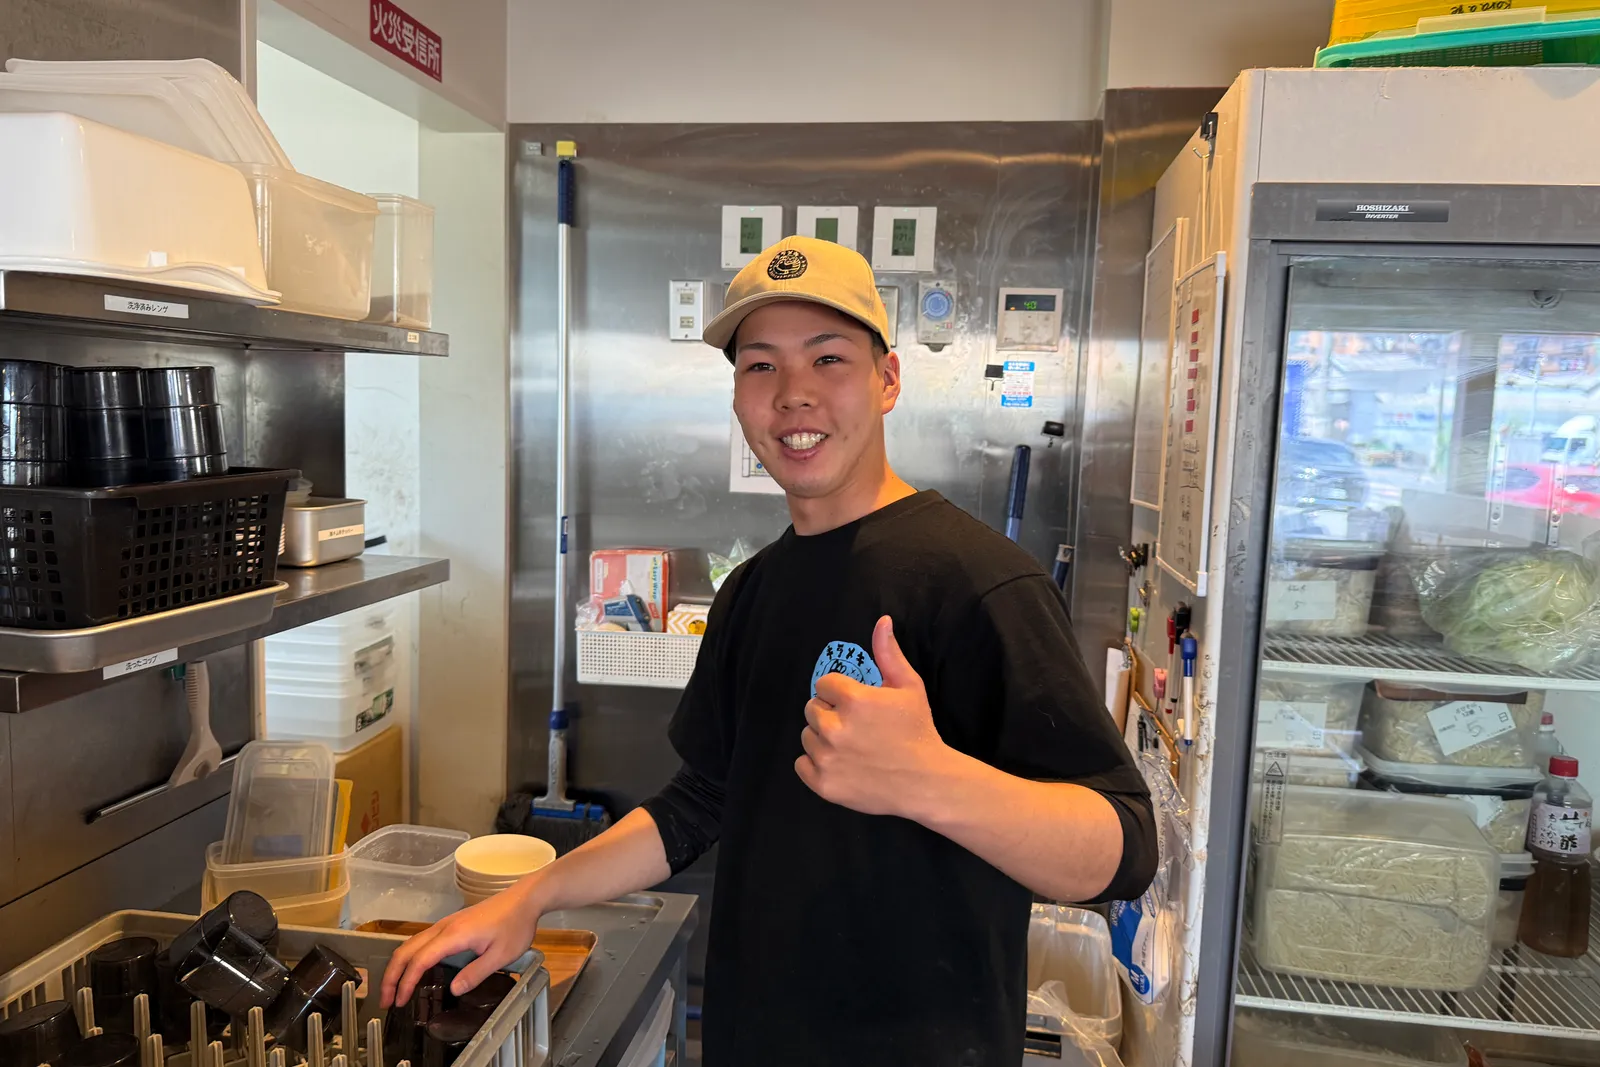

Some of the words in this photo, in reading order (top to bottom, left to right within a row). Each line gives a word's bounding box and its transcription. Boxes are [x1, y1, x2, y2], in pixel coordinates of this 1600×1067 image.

[373, 3, 440, 74] 火災受信所
[1356, 204, 1409, 212] HOSHIZAKI
[826, 643, 866, 667] キラメキ
